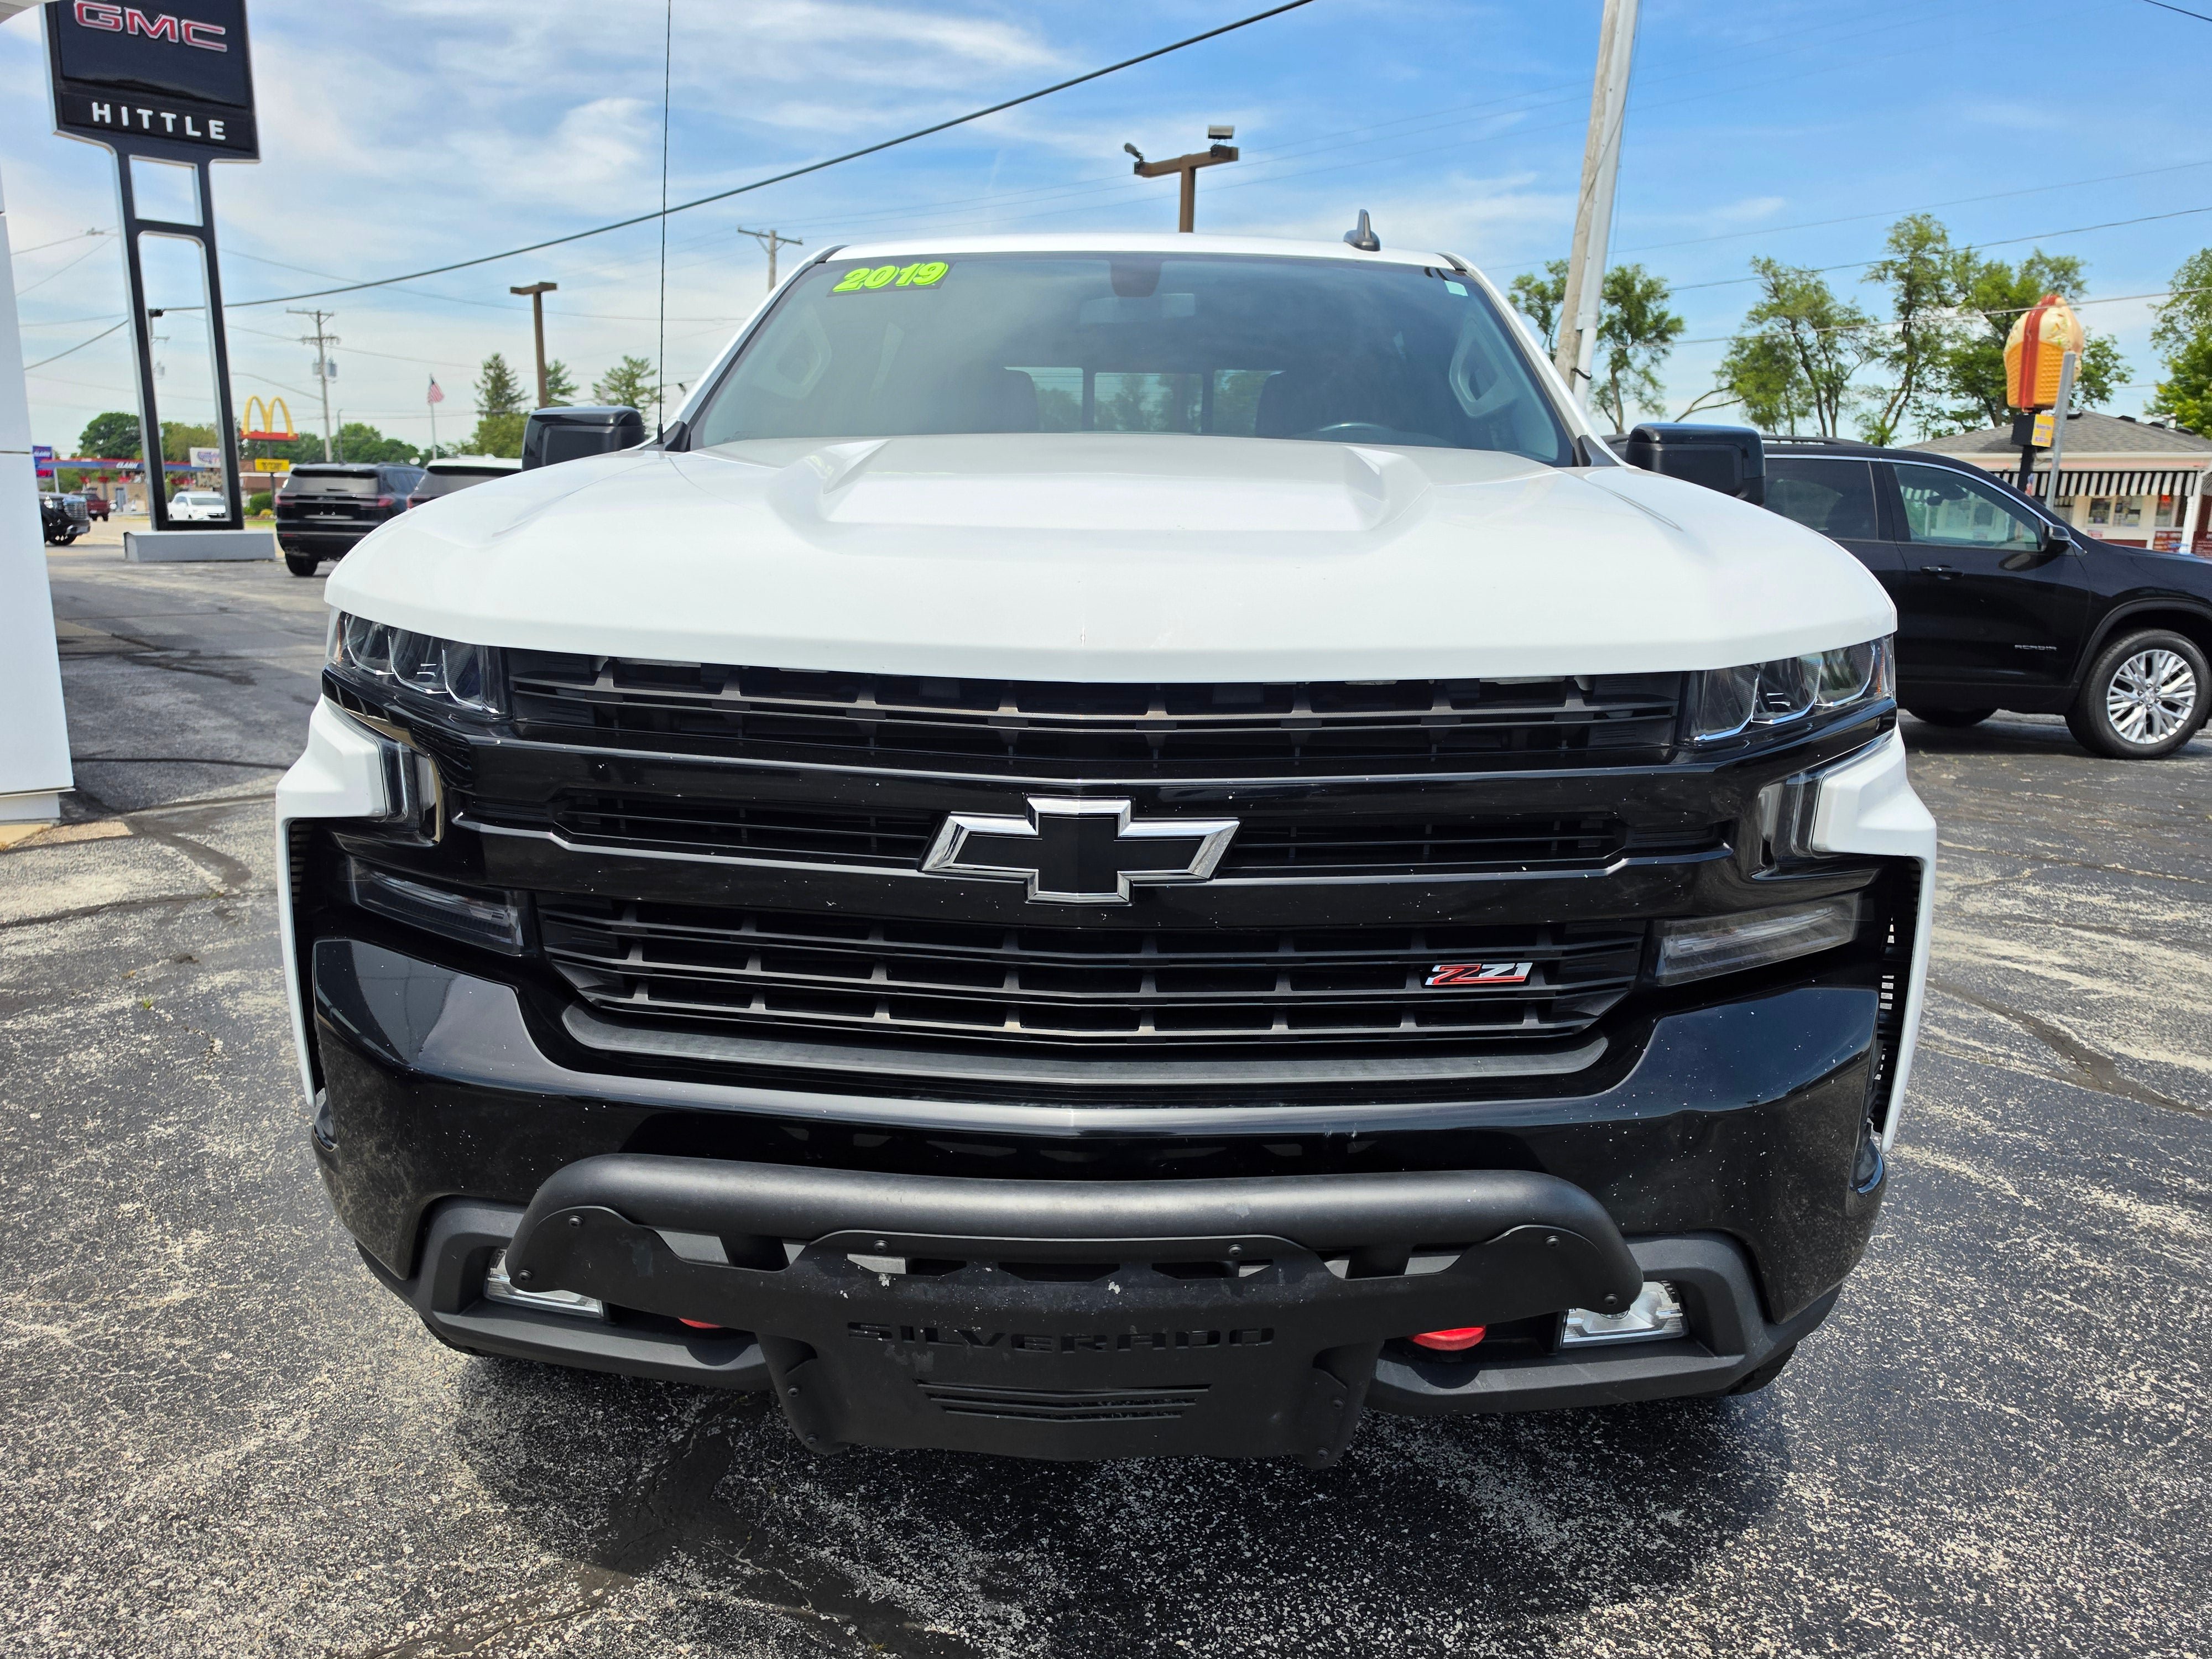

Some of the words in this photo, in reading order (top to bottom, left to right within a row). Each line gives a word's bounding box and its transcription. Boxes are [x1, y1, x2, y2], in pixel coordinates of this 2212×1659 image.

[74, 0, 227, 53] GMC
[92, 102, 226, 140] HITTLE
[832, 262, 949, 292] 2019
[116, 461, 138, 469] CLARK
[1425, 962, 1533, 985] Z71
[847, 1322, 1275, 1354] SILVERADO
